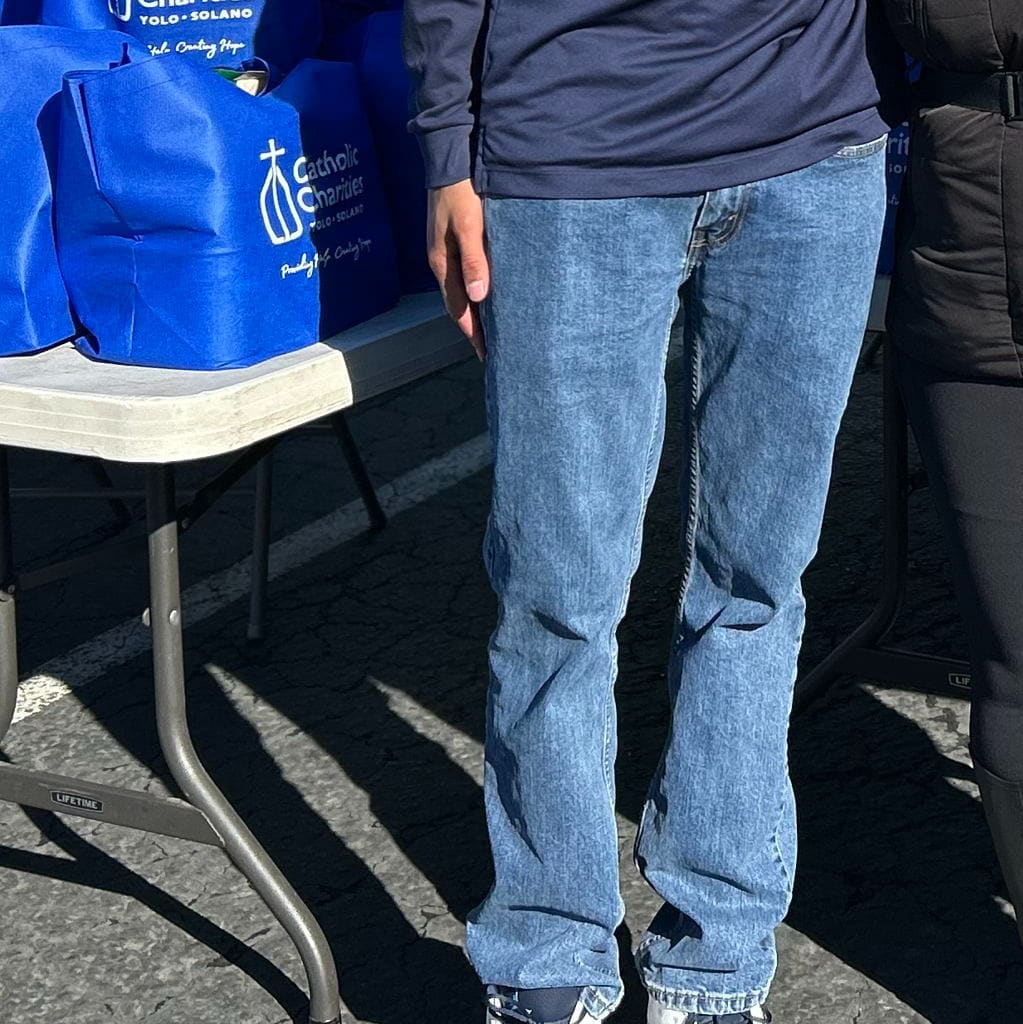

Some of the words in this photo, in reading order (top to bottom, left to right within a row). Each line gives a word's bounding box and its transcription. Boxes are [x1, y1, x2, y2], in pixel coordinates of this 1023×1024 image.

[139, 15, 180, 26] YOLO
[190, 8, 253, 21] SOLANO
[293, 143, 359, 184] Catholic
[297, 176, 363, 213] Charities
[56, 793, 98, 810] LIFETIME
